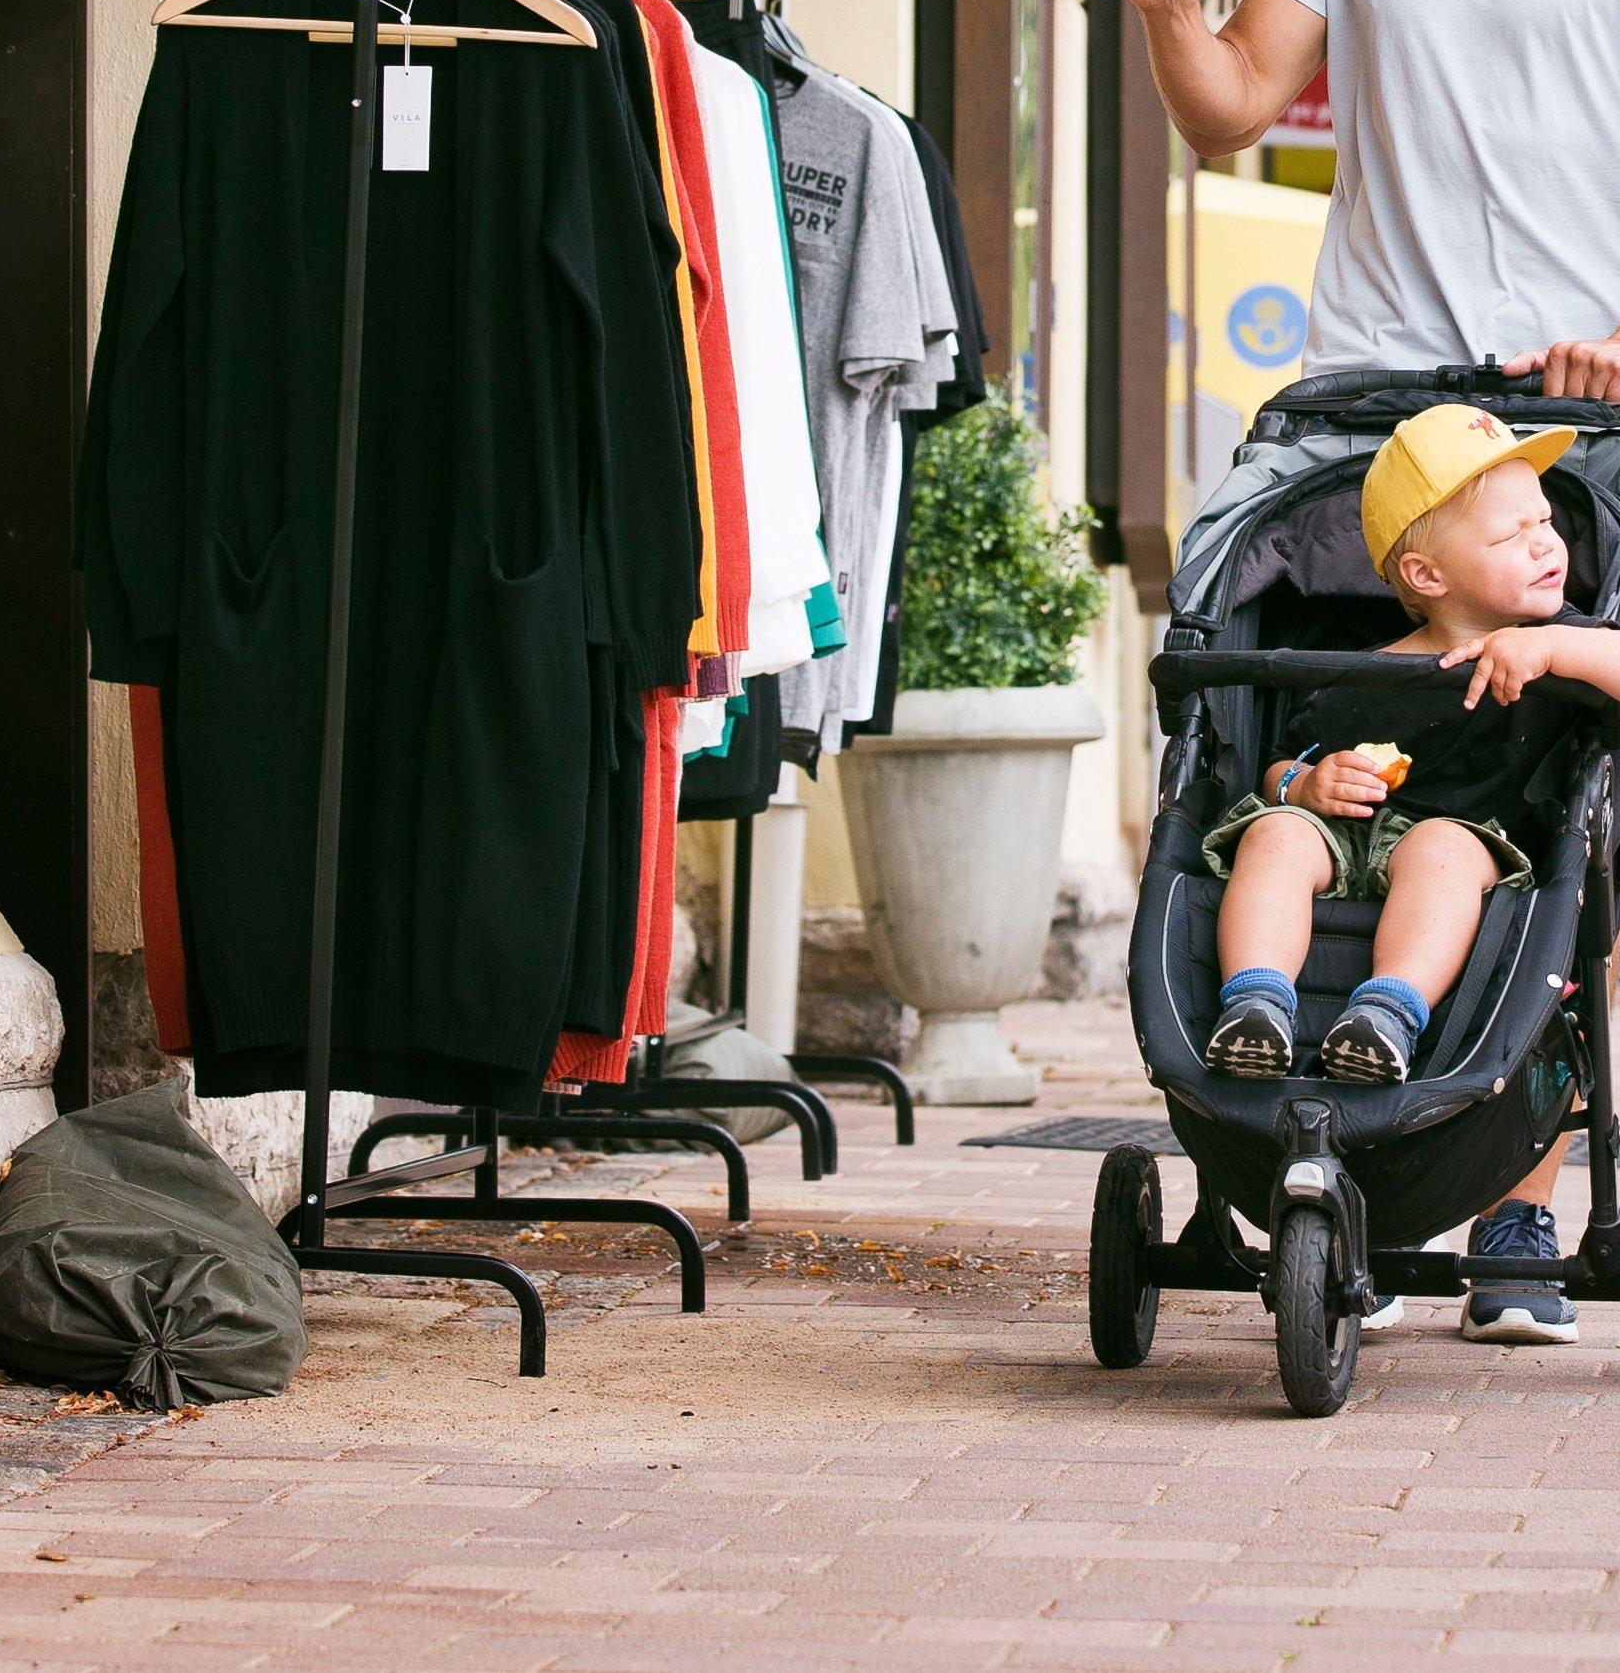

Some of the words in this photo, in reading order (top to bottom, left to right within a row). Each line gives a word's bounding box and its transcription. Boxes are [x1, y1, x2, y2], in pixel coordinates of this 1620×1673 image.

[392, 114, 421, 122] VILA
[782, 161, 847, 197] UPER
[790, 207, 837, 235] DRY
